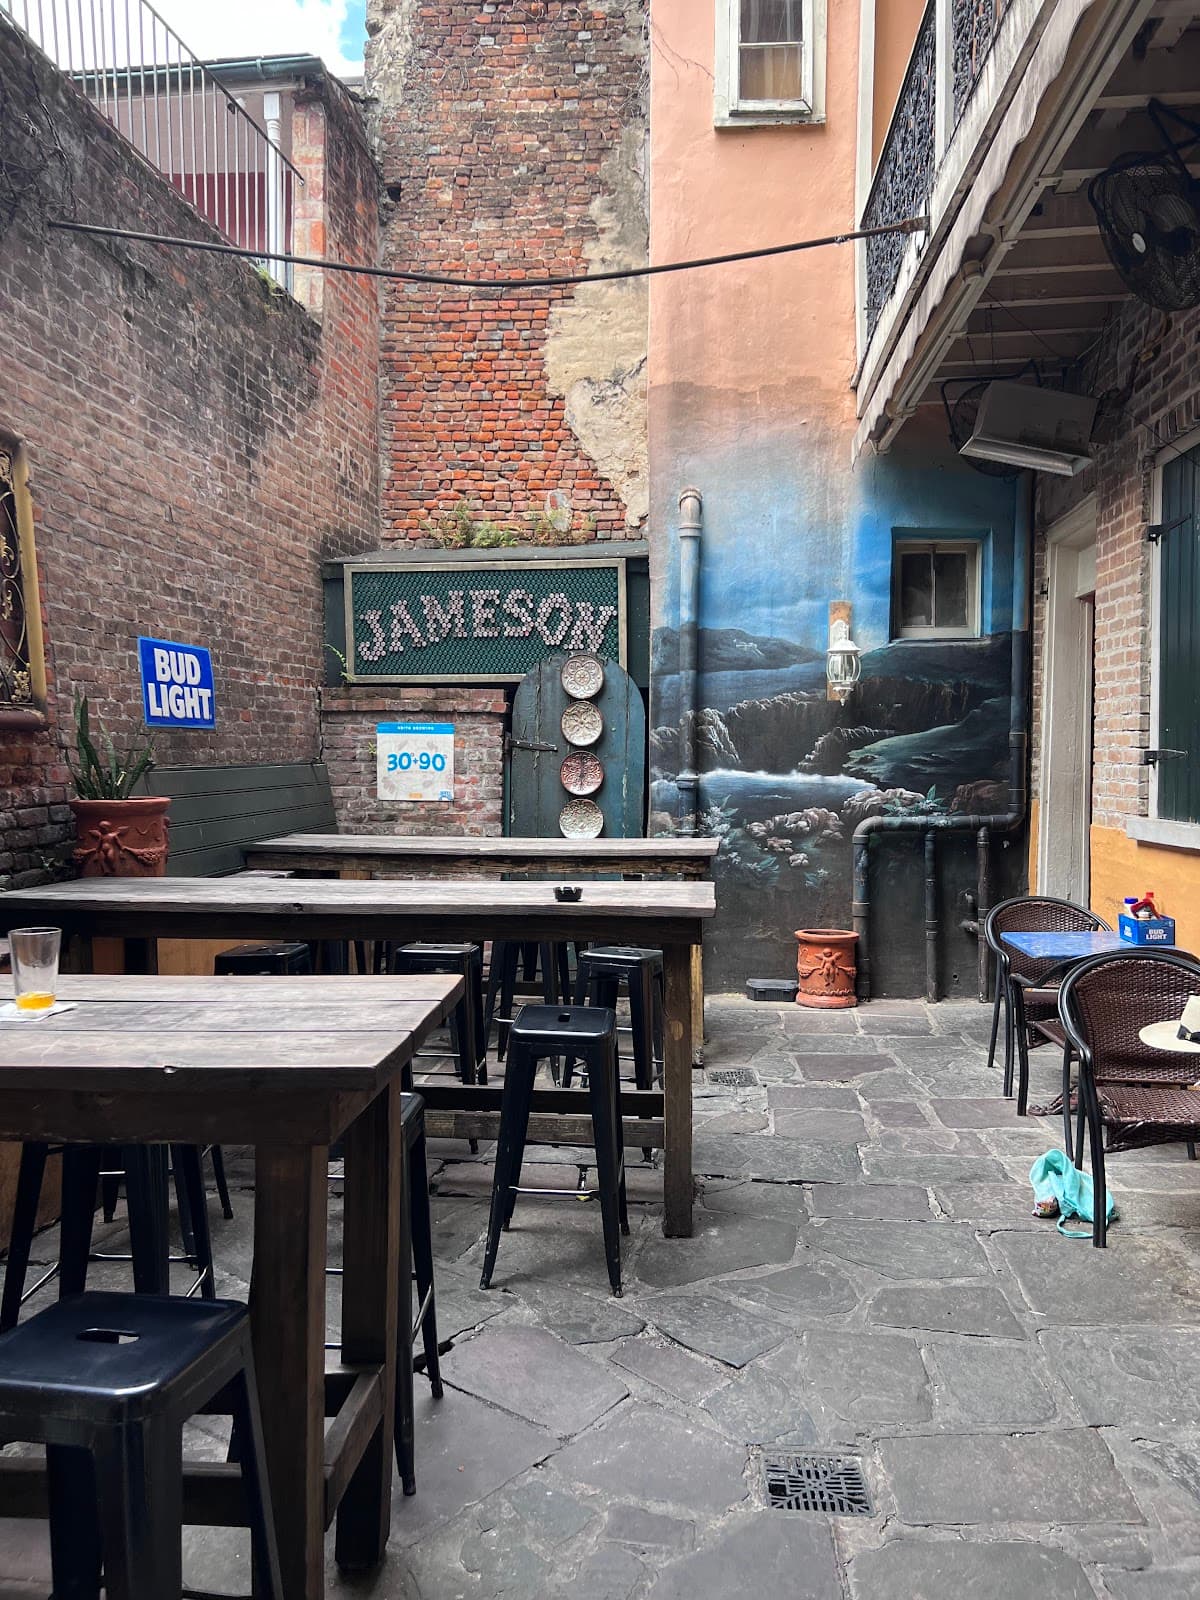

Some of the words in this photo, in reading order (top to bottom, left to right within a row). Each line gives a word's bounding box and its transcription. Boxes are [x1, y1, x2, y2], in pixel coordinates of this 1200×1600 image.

[358, 589, 617, 661] JAMESON
[154, 648, 201, 686] BUD
[147, 682, 212, 720] LIGHT
